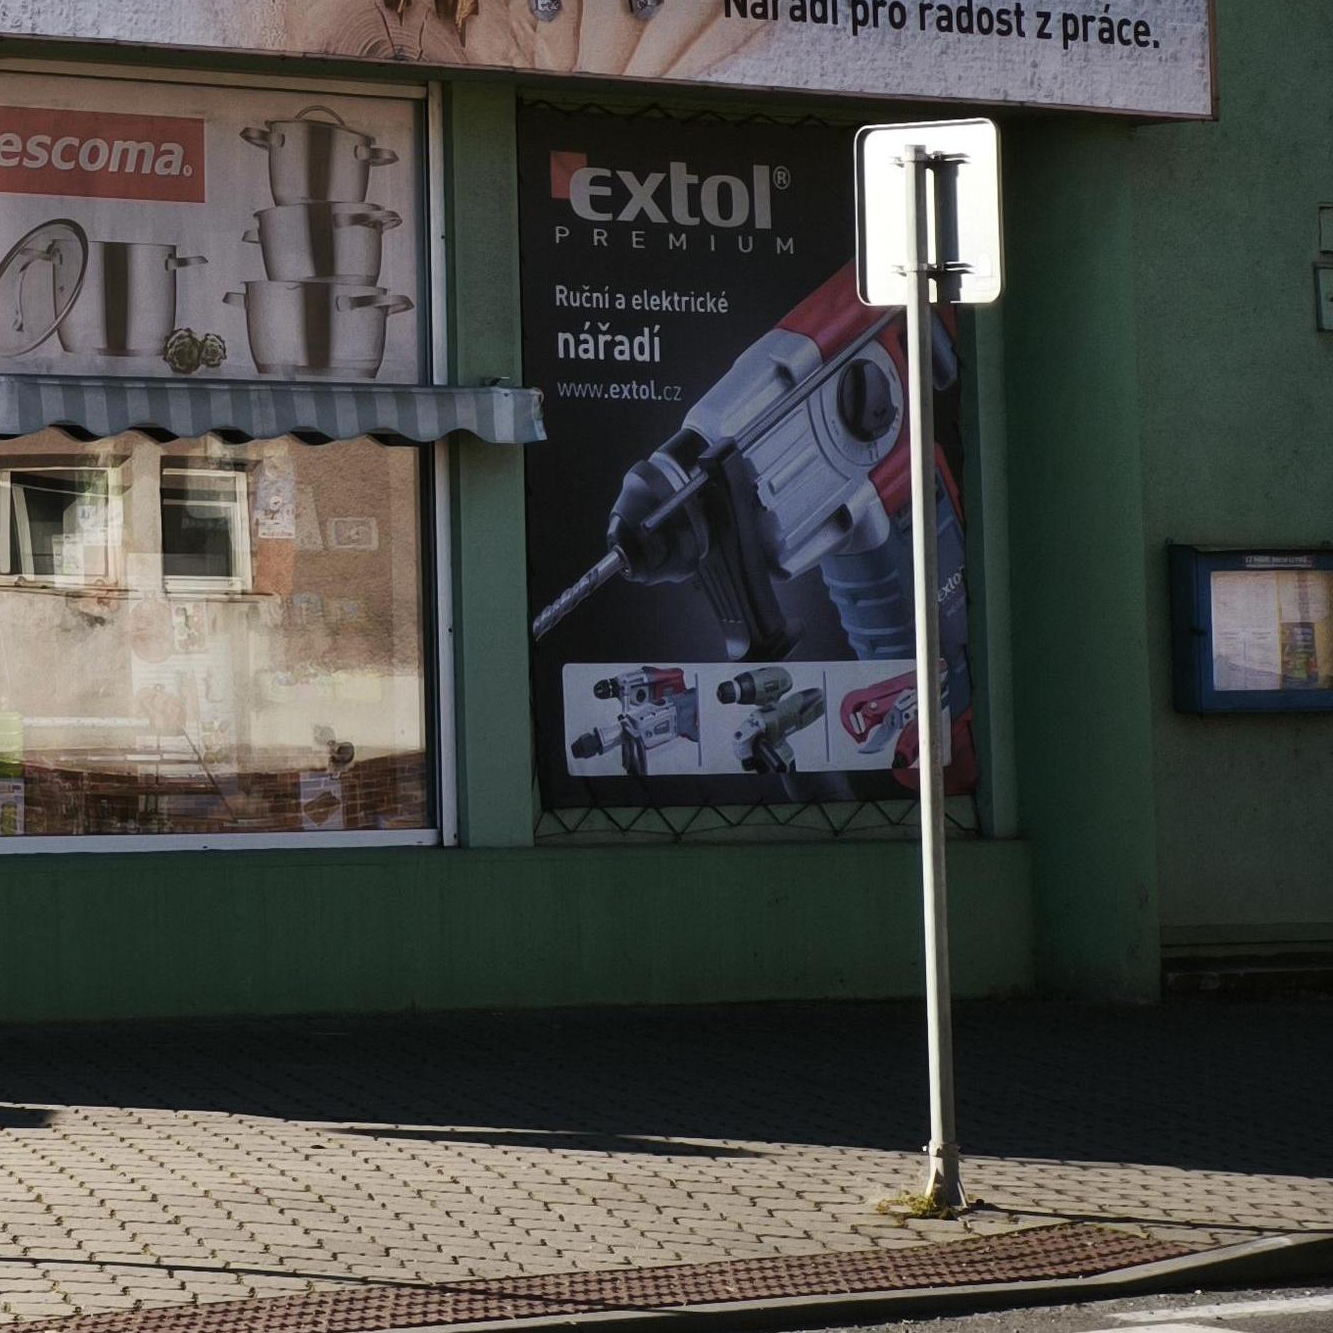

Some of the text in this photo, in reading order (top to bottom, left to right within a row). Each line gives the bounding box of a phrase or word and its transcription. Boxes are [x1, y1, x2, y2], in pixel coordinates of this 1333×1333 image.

[919, 0, 1027, 40] radost
[1036, 8, 1053, 41] z
[1063, 3, 1161, 50] práce.
[555, 226, 794, 254] PREMIUM
[555, 285, 729, 314] Ruční a elektrické
[557, 322, 661, 363] nářadí
[556, 380, 682, 402] www.extol.cz
